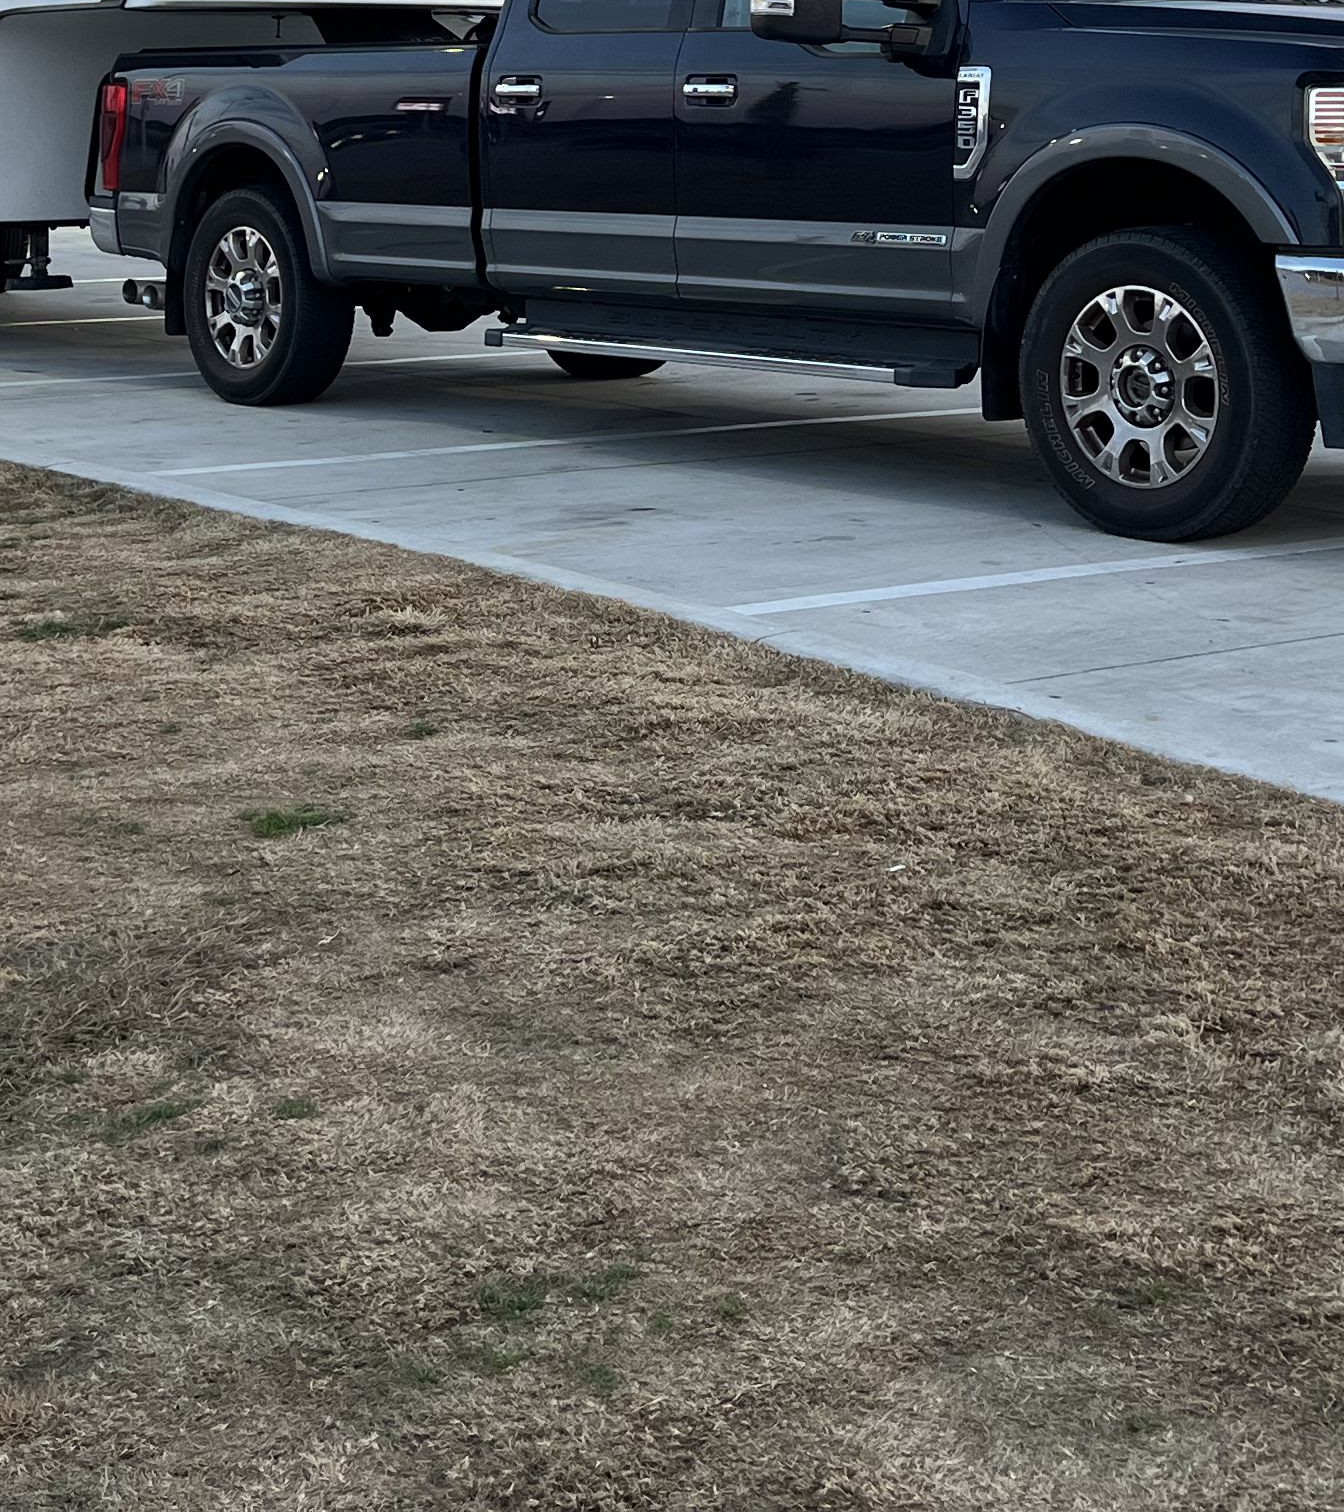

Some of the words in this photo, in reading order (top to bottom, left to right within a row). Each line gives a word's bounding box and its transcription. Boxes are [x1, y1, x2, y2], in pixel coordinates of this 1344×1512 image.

[132, 78, 185, 104] FX4
[879, 233, 907, 241] POWER
[909, 235, 943, 243] STROKE
[1169, 282, 1230, 407] MICHELIN
[1036, 368, 1096, 489] MICHELIN
